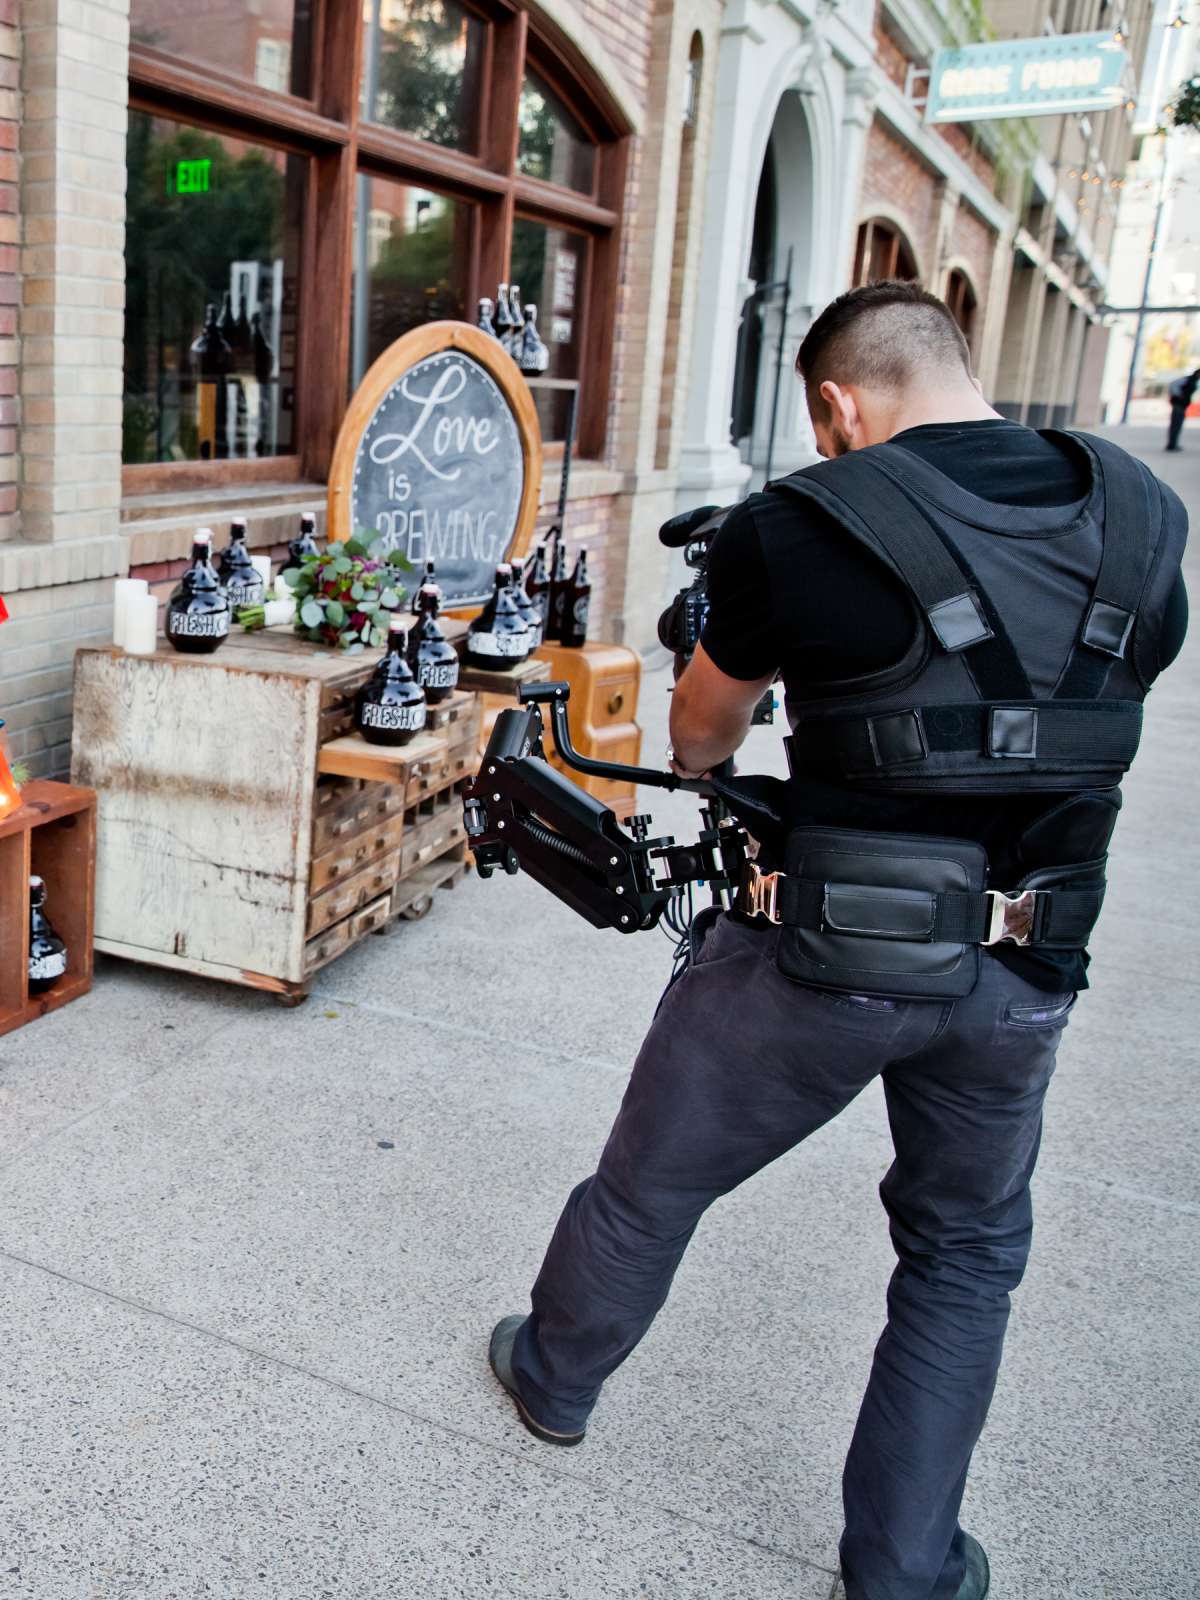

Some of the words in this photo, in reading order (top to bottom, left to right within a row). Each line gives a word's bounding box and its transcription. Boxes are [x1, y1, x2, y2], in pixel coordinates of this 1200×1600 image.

[176, 159, 211, 193] EXIT
[369, 363, 500, 481] Love
[387, 469, 411, 502] is
[361, 702, 412, 731] FRESH
